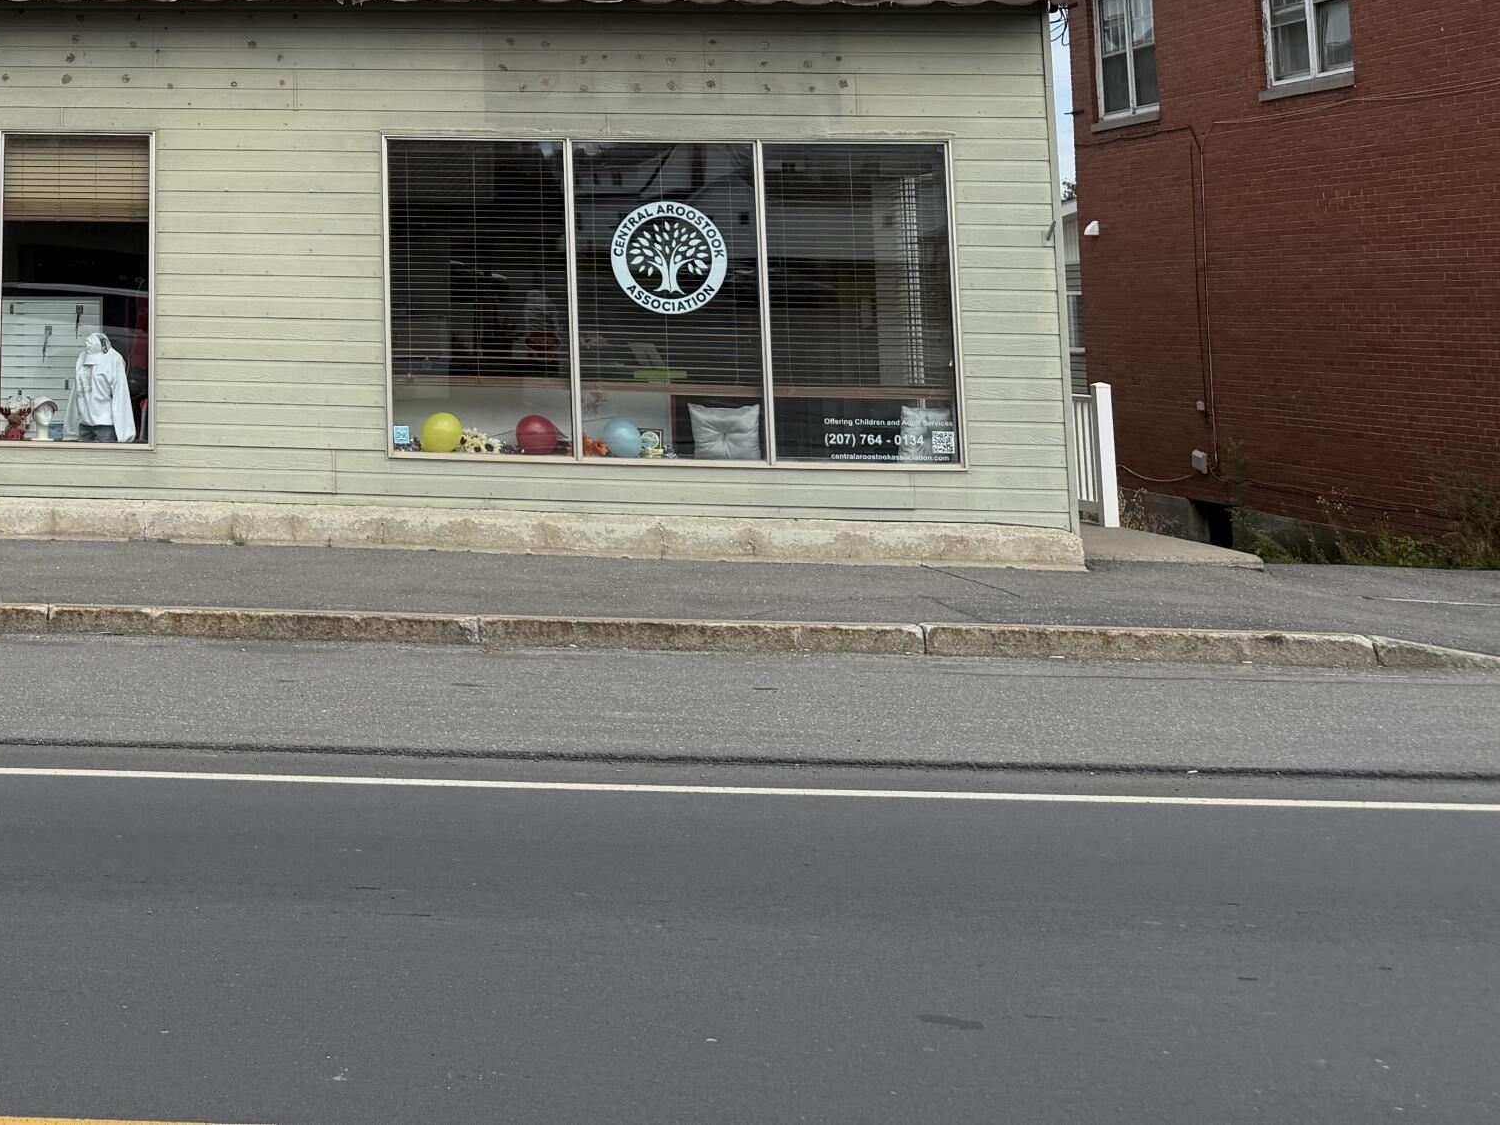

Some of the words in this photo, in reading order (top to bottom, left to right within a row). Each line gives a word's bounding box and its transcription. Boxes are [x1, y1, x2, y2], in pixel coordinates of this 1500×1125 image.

[613, 208, 654, 257] CENTRAL
[656, 204, 725, 258] AROOSTOOK
[626, 284, 716, 312] ASSOCIATION
[824, 418, 853, 427] Offering
[854, 418, 885, 426] Children
[922, 419, 953, 427] Services
[824, 433, 856, 447] (207)
[860, 434, 883, 445] 764
[894, 434, 925, 446] 0134
[831, 453, 949, 461] centralaroostookassociation.com
